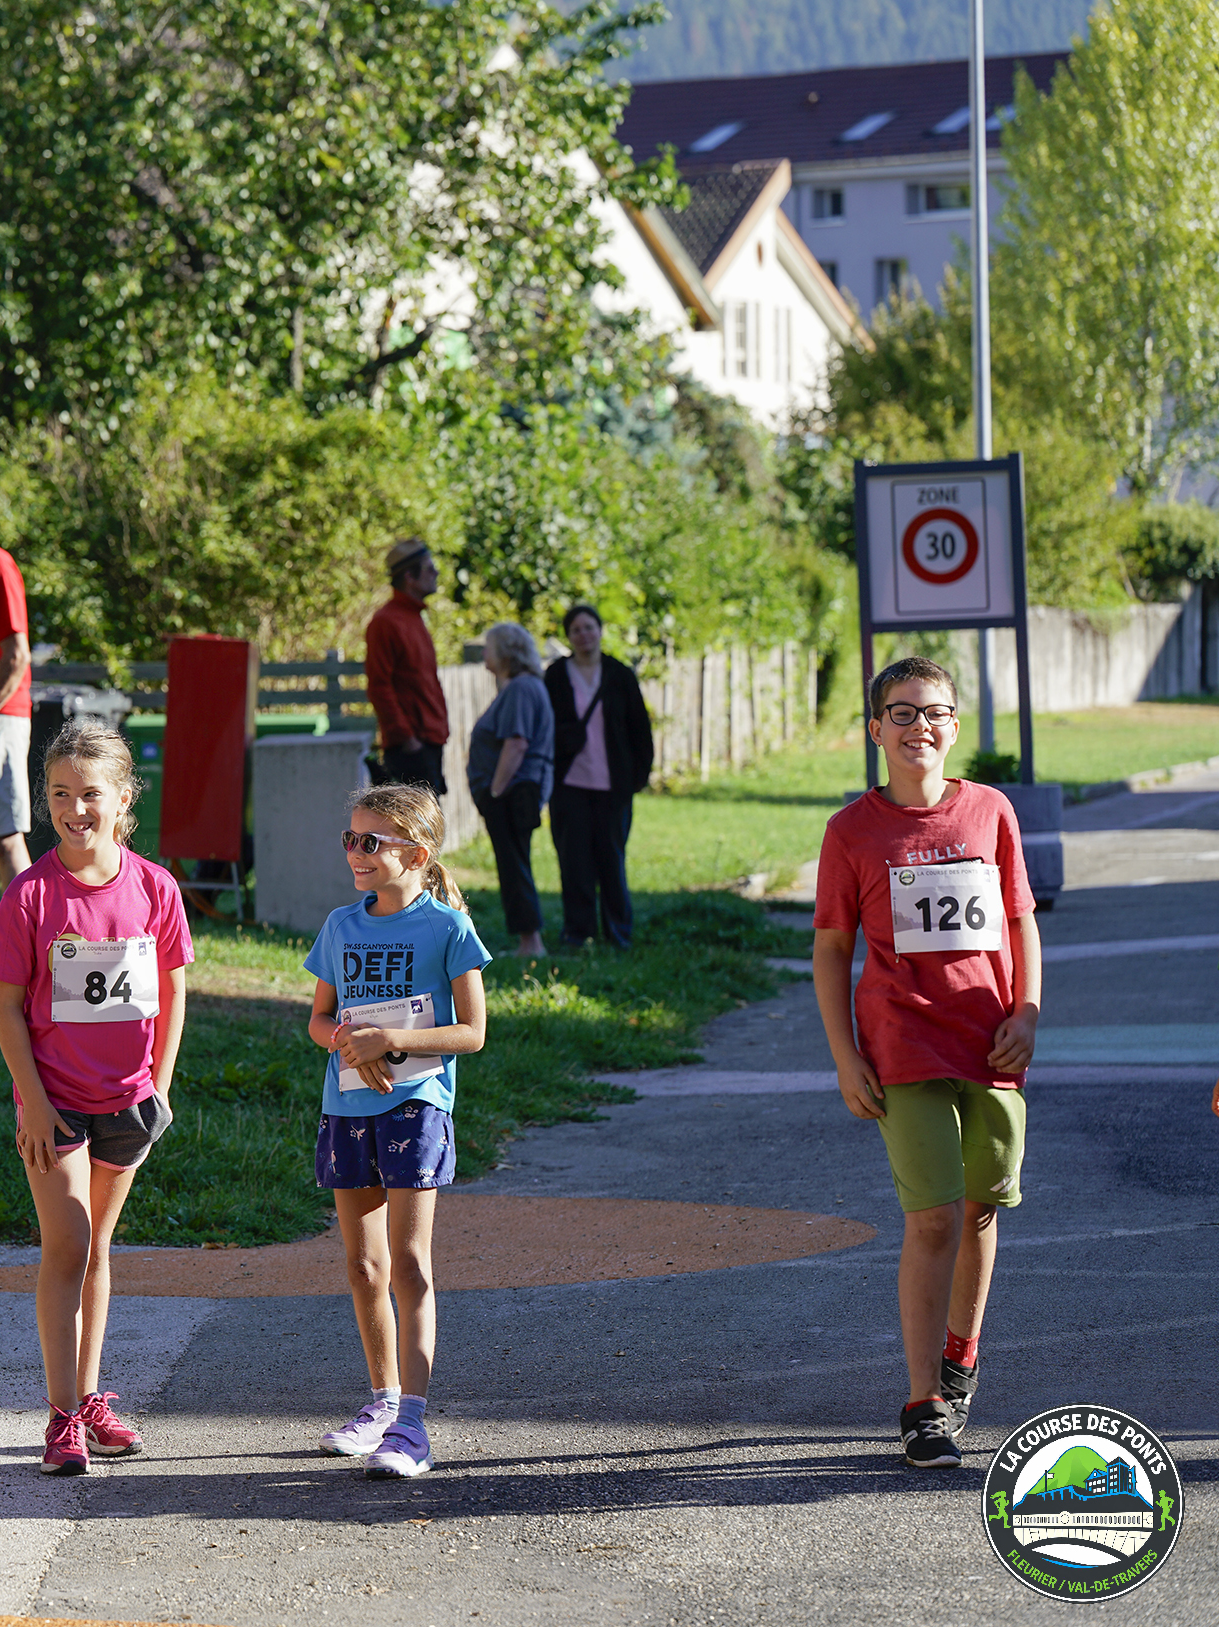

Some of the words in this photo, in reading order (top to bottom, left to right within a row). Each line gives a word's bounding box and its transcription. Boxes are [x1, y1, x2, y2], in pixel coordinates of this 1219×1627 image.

[917, 486, 960, 505] ZONE
[925, 531, 956, 561] 30
[907, 843, 967, 864] FULLY
[914, 896, 986, 932] 126
[343, 951, 414, 983] DEFI
[84, 970, 132, 1005] 84
[343, 984, 413, 999] JEUNESSE
[388, 1003, 406, 1011] PONTS
